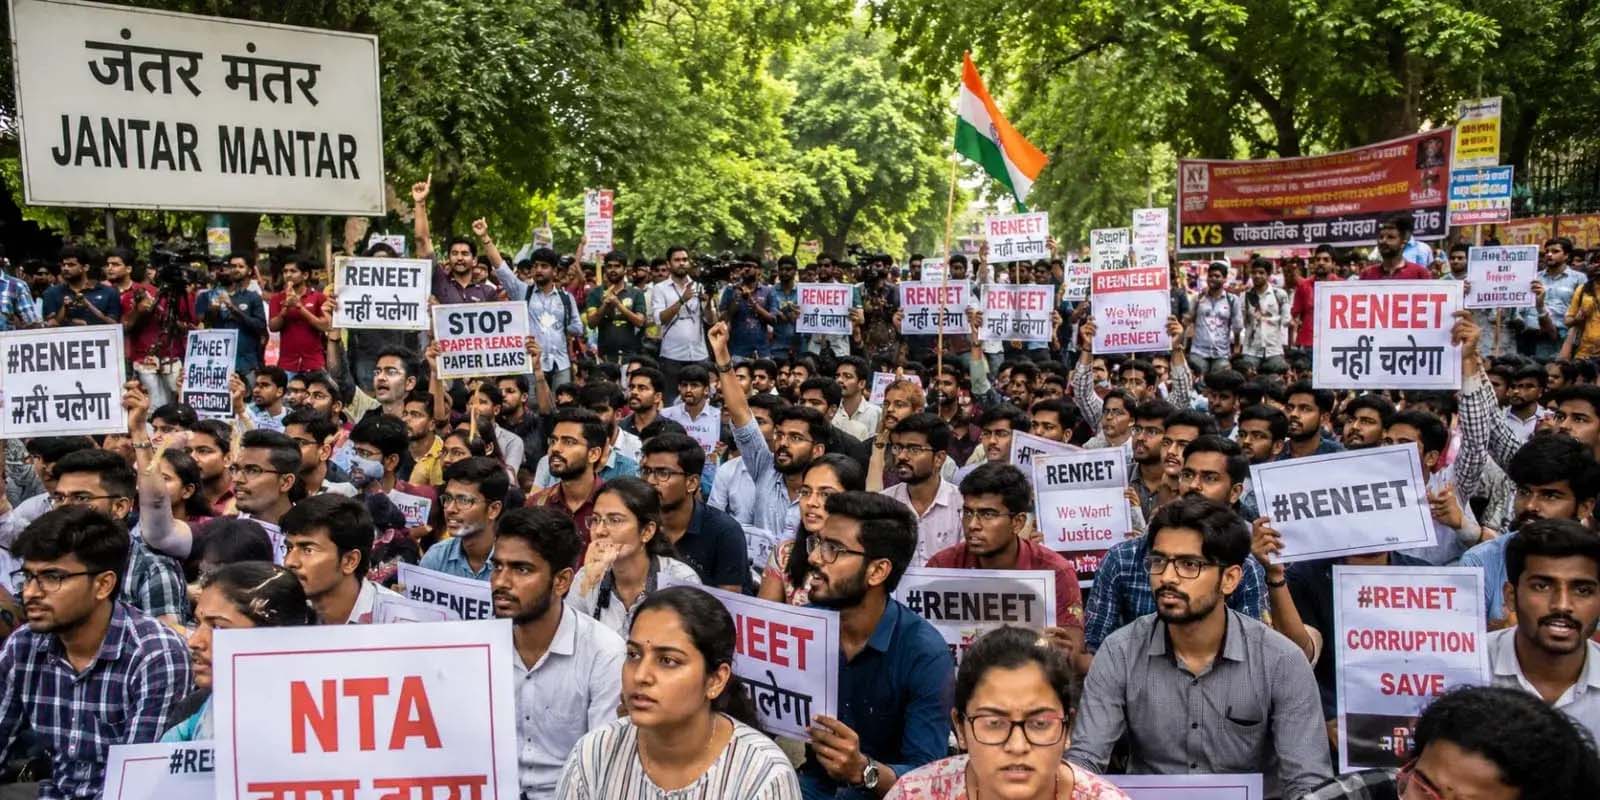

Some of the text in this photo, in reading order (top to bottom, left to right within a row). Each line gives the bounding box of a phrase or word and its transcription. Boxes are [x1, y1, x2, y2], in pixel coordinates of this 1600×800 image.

[85, 28, 321, 106] जंतर मंतर
[51, 115, 360, 180] JANTAR MANTAR
[991, 217, 1042, 236] RENEET
[1183, 224, 1222, 245] KYS
[345, 266, 421, 287] RENEET
[345, 294, 419, 321] नहीं चलेगा
[802, 288, 848, 305] RENEET
[906, 286, 963, 305] RENEET
[986, 291, 1047, 310] RENEET
[448, 310, 513, 335] STOP
[1330, 294, 1448, 329] RENEET
[7, 339, 111, 374] #RENEET
[443, 351, 526, 369] PAPER LEAKS
[1331, 335, 1445, 380] नहीं चलेगा
[53, 381, 112, 422] चलेगा
[1056, 504, 1112, 519] We Want
[1272, 479, 1409, 522] #RENEET
[1058, 525, 1112, 542] Justice
[409, 585, 495, 620] #RENEE
[906, 590, 1036, 623] #RENEET
[1357, 586, 1457, 610] #RENET
[1346, 629, 1475, 653] CORRUPTION
[1380, 672, 1445, 697] SAVE
[290, 675, 443, 754] NTA
[169, 748, 215, 775] #RE
